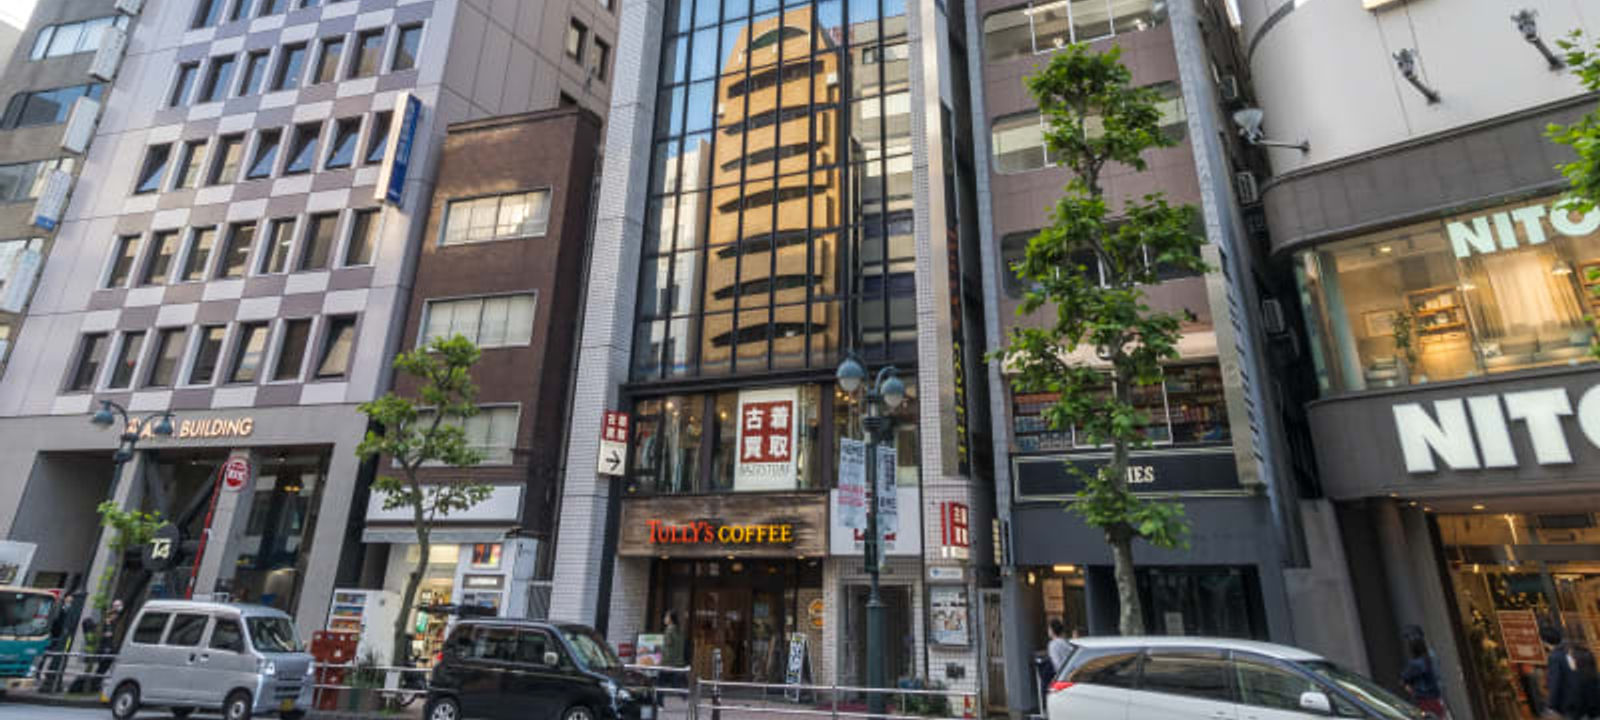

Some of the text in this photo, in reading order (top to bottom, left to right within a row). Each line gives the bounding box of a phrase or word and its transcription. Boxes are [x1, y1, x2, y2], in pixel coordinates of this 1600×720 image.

[180, 417, 252, 438] BUILDING
[744, 405, 788, 430] 古着
[744, 435, 788, 459] 買取
[645, 518, 794, 544] TULLY'S COFFEE
